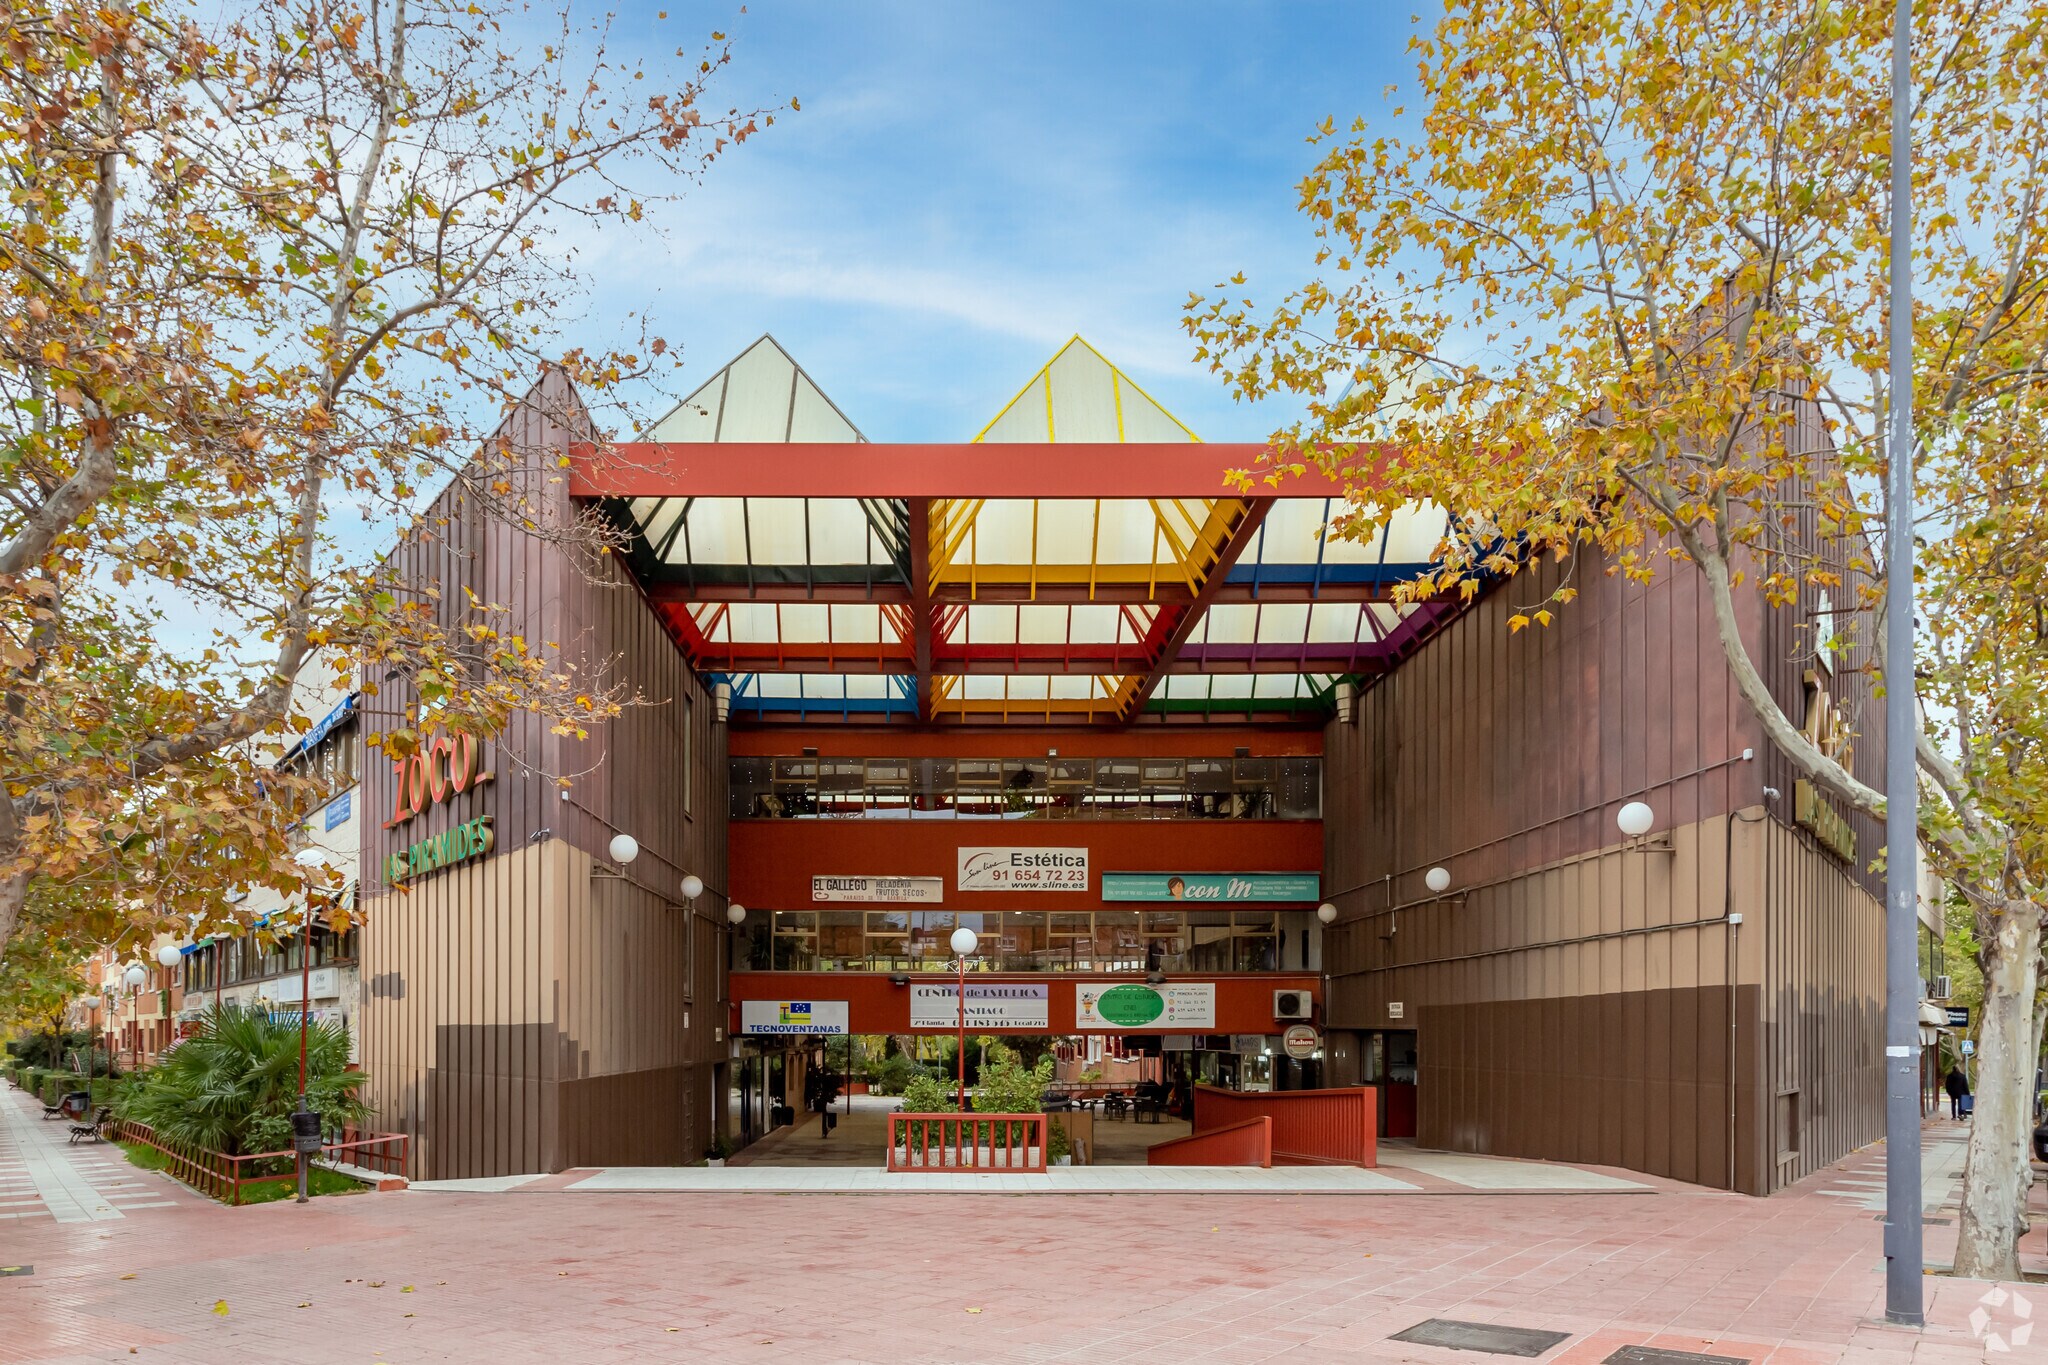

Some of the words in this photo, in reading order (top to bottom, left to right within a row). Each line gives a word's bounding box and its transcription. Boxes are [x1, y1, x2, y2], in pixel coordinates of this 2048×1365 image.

[409, 815, 491, 878] PIRAMIDES
[1011, 853, 1085, 867] Estética
[992, 870, 1009, 881] 91
[1014, 870, 1041, 881] 654
[1045, 870, 1063, 881] 72
[1067, 870, 1085, 881] 23
[813, 879, 824, 891] EL
[826, 879, 867, 891] GALLEGO
[1011, 881, 1085, 889] www.sline.es
[1184, 885, 1221, 899] con
[1226, 877, 1253, 899] M
[875, 888, 901, 896] FRUTOS
[902, 889, 925, 897] SECOS
[966, 989, 980, 997] de
[749, 1024, 841, 1033] TECNOVENTANAS
